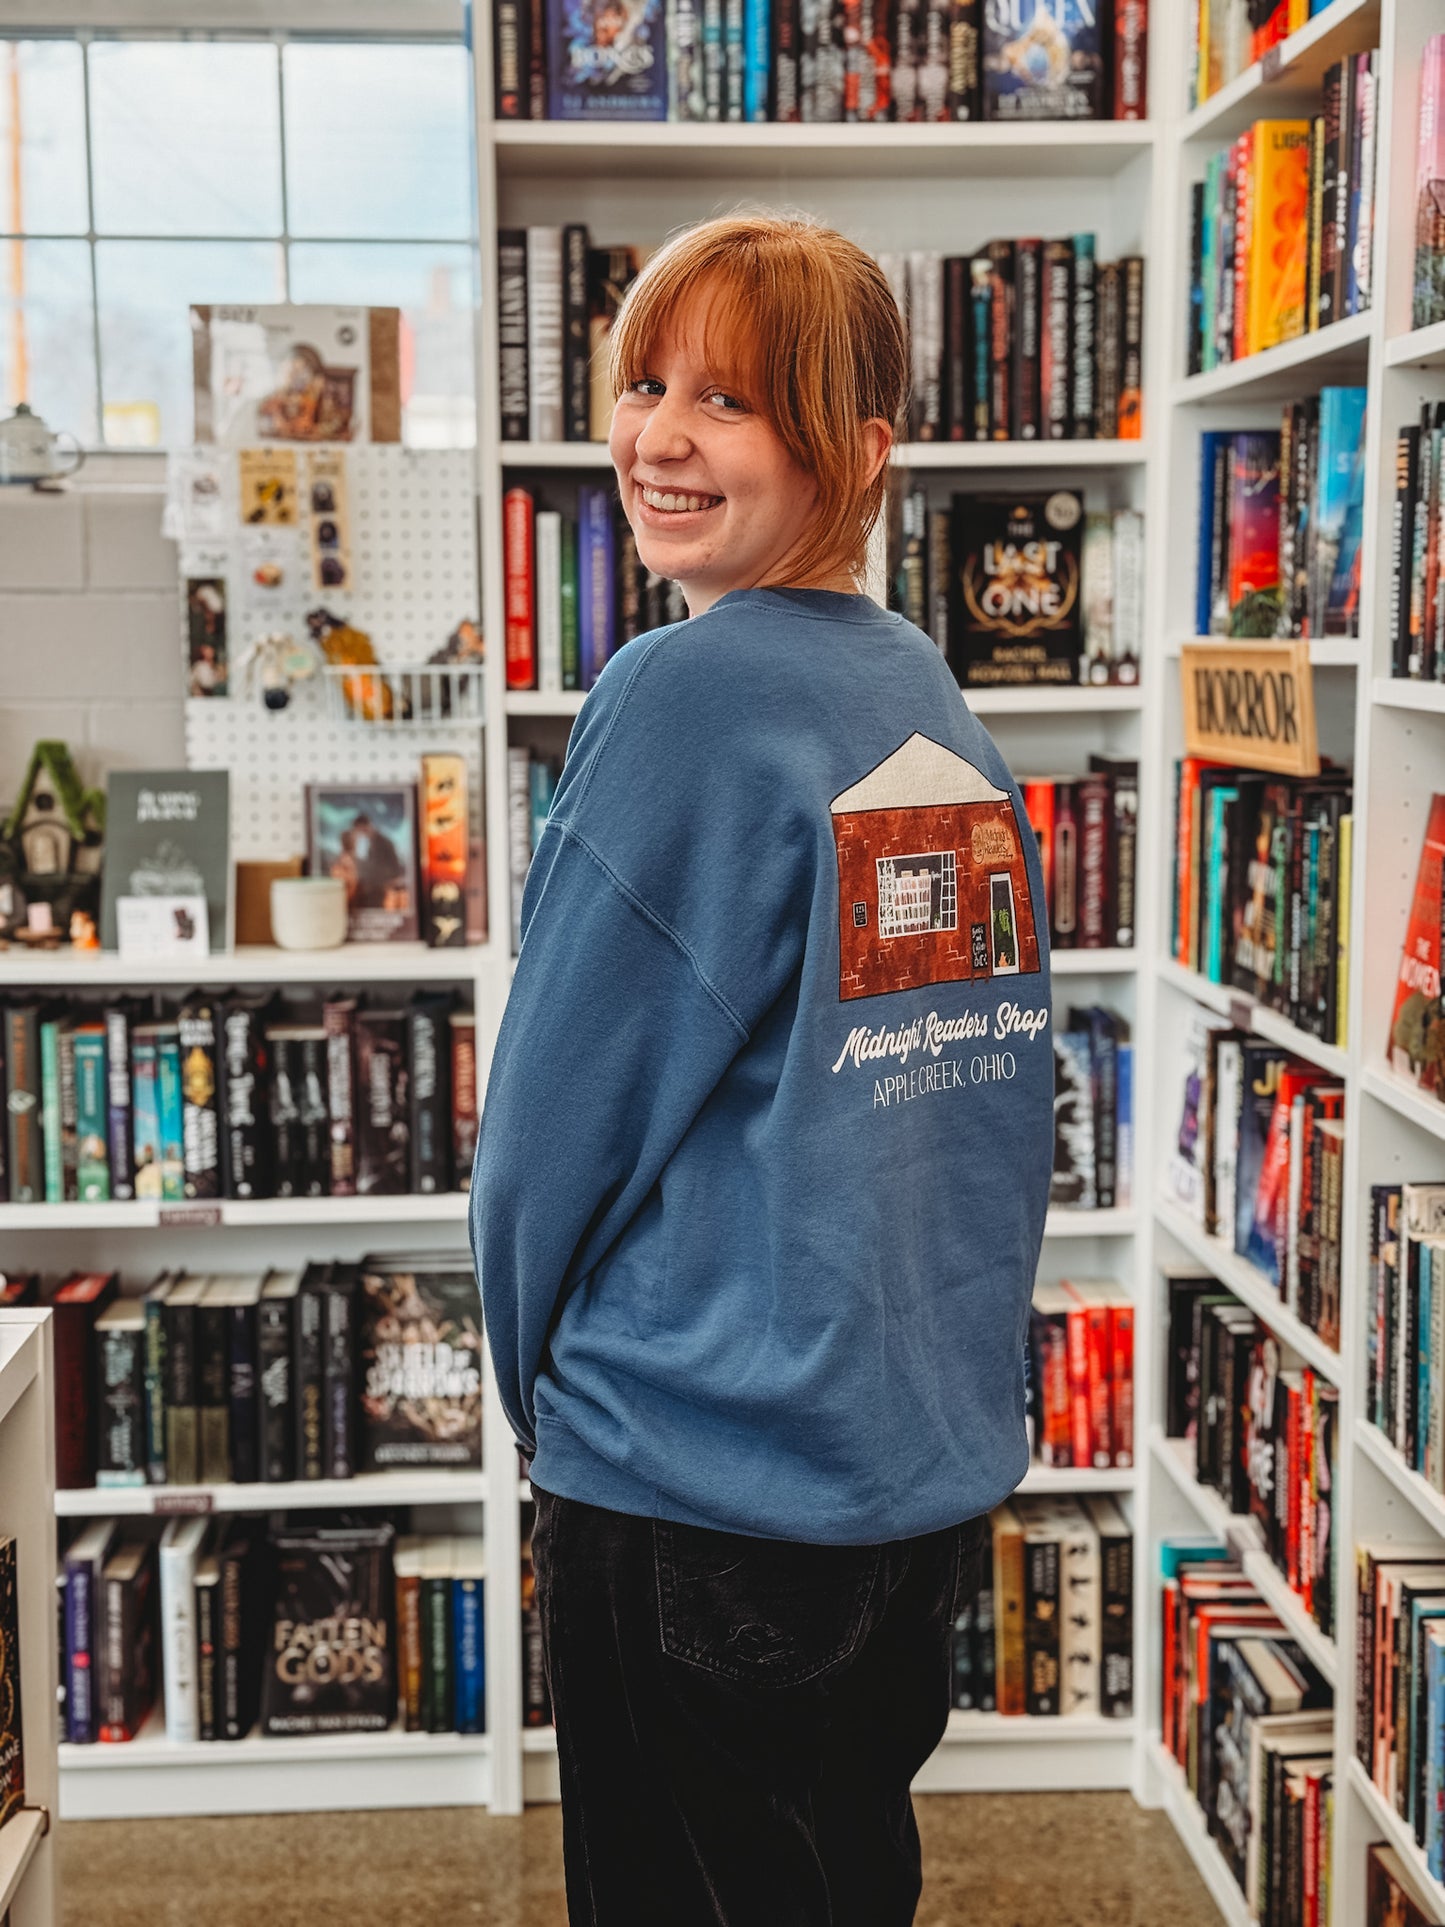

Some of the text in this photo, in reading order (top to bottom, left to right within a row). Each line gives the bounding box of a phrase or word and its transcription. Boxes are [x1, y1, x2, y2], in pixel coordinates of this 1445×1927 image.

[982, 583, 1062, 617] ONE
[1194, 667, 1298, 744] HORROR
[831, 1001, 1048, 1073] Midnight Readers Shop
[873, 1051, 1016, 1109] APPLE CREEK, OHIO
[274, 1618, 387, 1651] FALLEN
[276, 1645, 383, 1685] GODS
